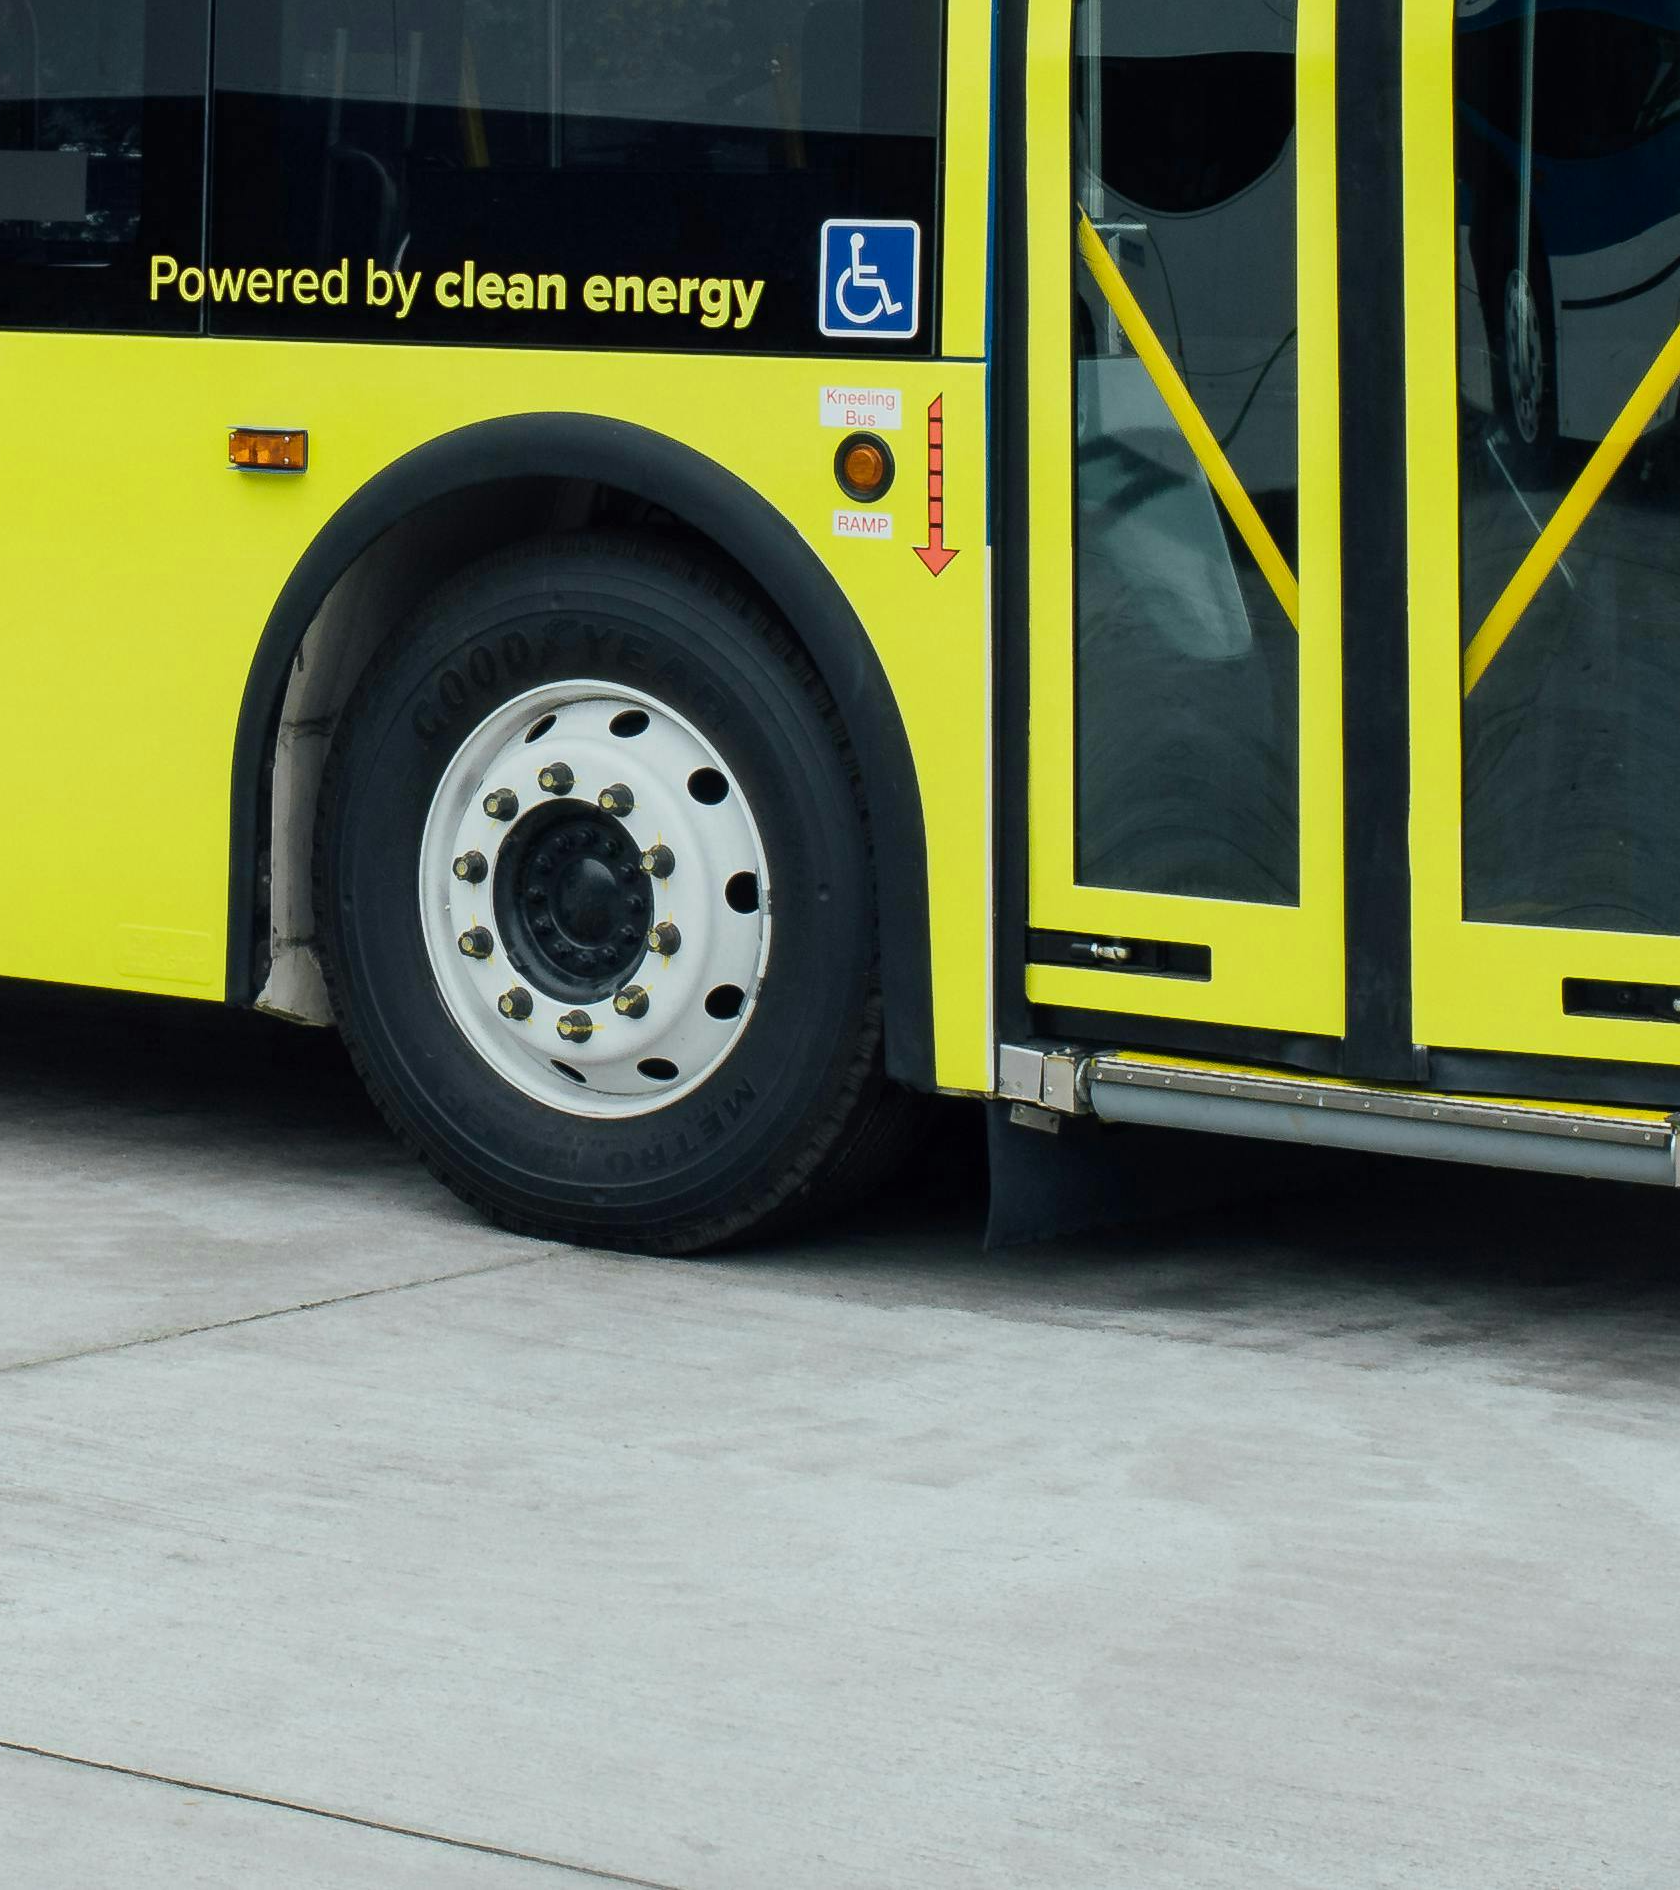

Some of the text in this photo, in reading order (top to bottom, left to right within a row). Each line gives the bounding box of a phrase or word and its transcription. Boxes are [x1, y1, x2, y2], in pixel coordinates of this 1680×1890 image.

[149, 254, 766, 330] Powered by clean energy
[826, 388, 896, 410] Kneeling
[845, 409, 877, 427] Bus
[837, 515, 889, 534] RAMP
